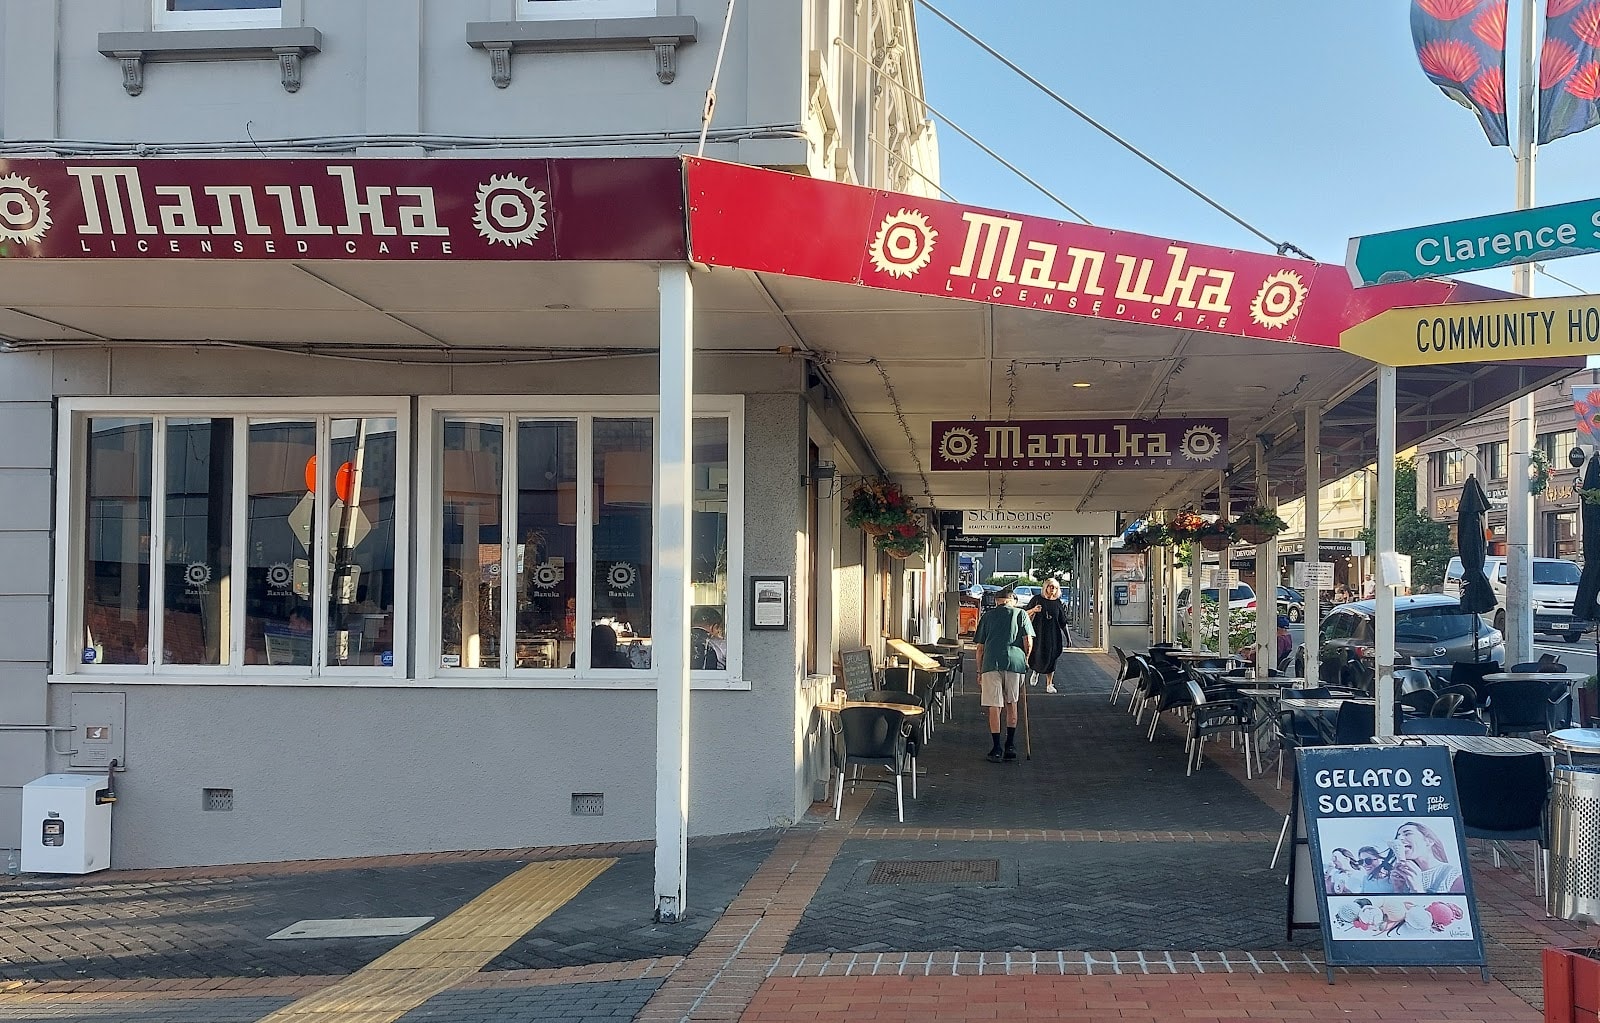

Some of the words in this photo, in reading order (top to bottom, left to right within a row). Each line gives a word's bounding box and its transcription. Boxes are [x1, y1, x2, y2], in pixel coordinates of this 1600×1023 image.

[66, 166, 449, 236] Manuka
[81, 240, 309, 254] LICENSED
[345, 240, 453, 254] CAFE
[950, 211, 1236, 314] Manuka
[1415, 222, 1577, 266] Clarence
[945, 279, 1126, 316] LICENSED
[1151, 308, 1228, 329] CAFE
[1416, 310, 1556, 353] COMMUNITY
[984, 425, 1172, 459] Manuka
[984, 459, 1099, 467] LICENSED
[1315, 768, 1412, 788] GELATO
[1421, 768, 1442, 787] &
[1318, 793, 1418, 813] SORBET
